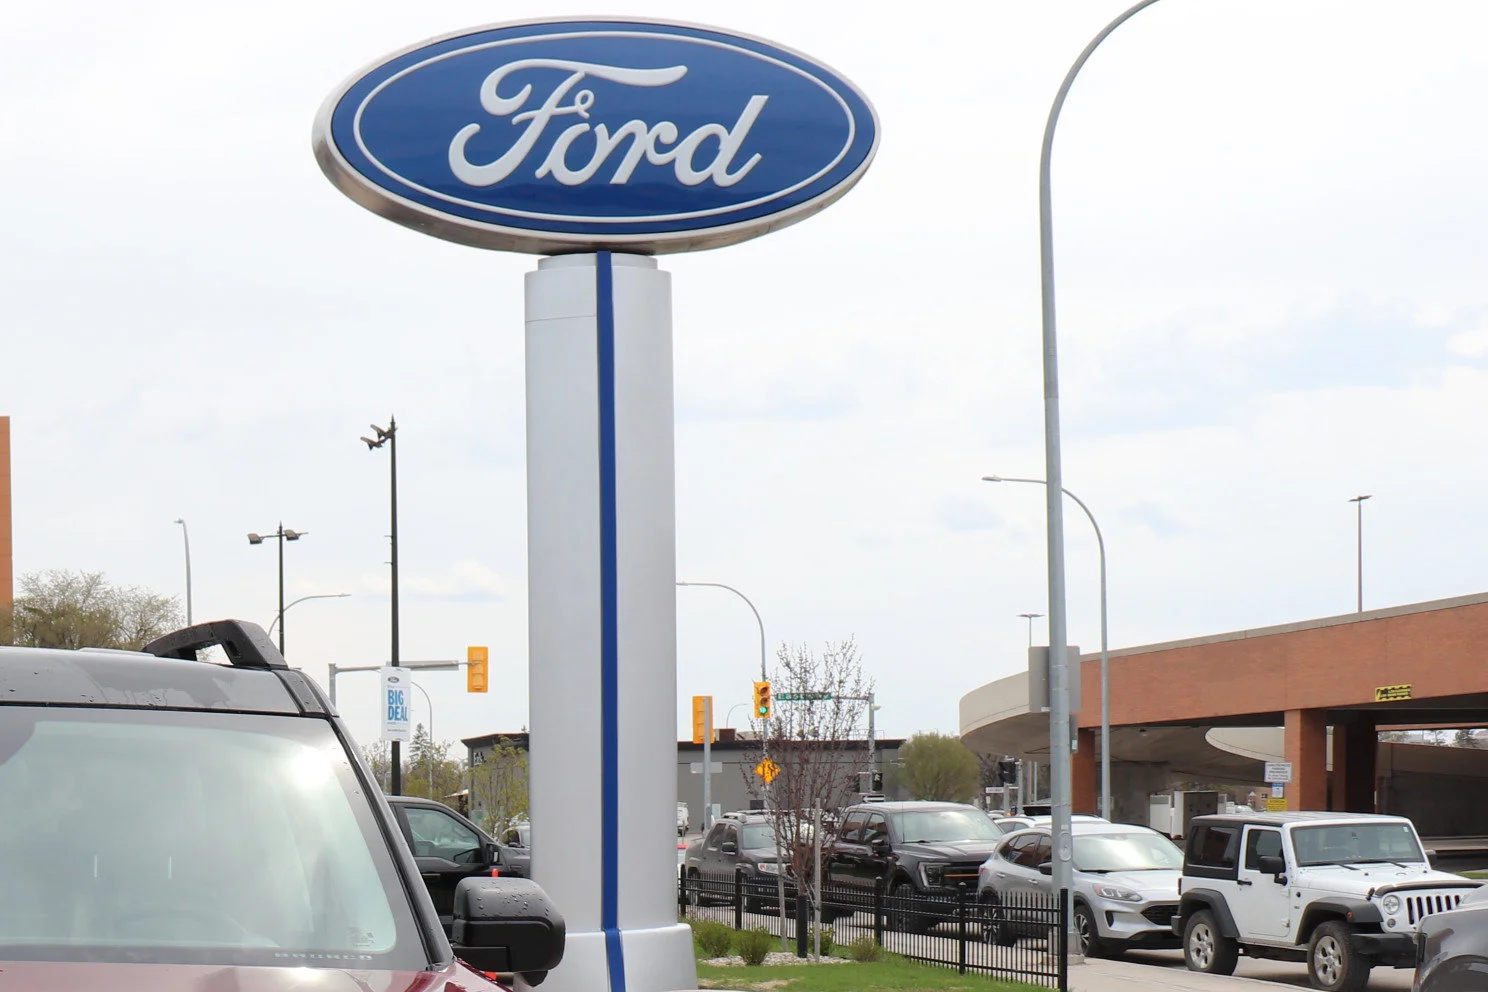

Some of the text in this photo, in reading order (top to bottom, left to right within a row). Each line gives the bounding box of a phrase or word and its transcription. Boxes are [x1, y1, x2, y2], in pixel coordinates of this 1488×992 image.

[448, 58, 770, 188] Ford
[388, 689, 404, 706] BIG
[388, 706, 408, 721] DEAL
